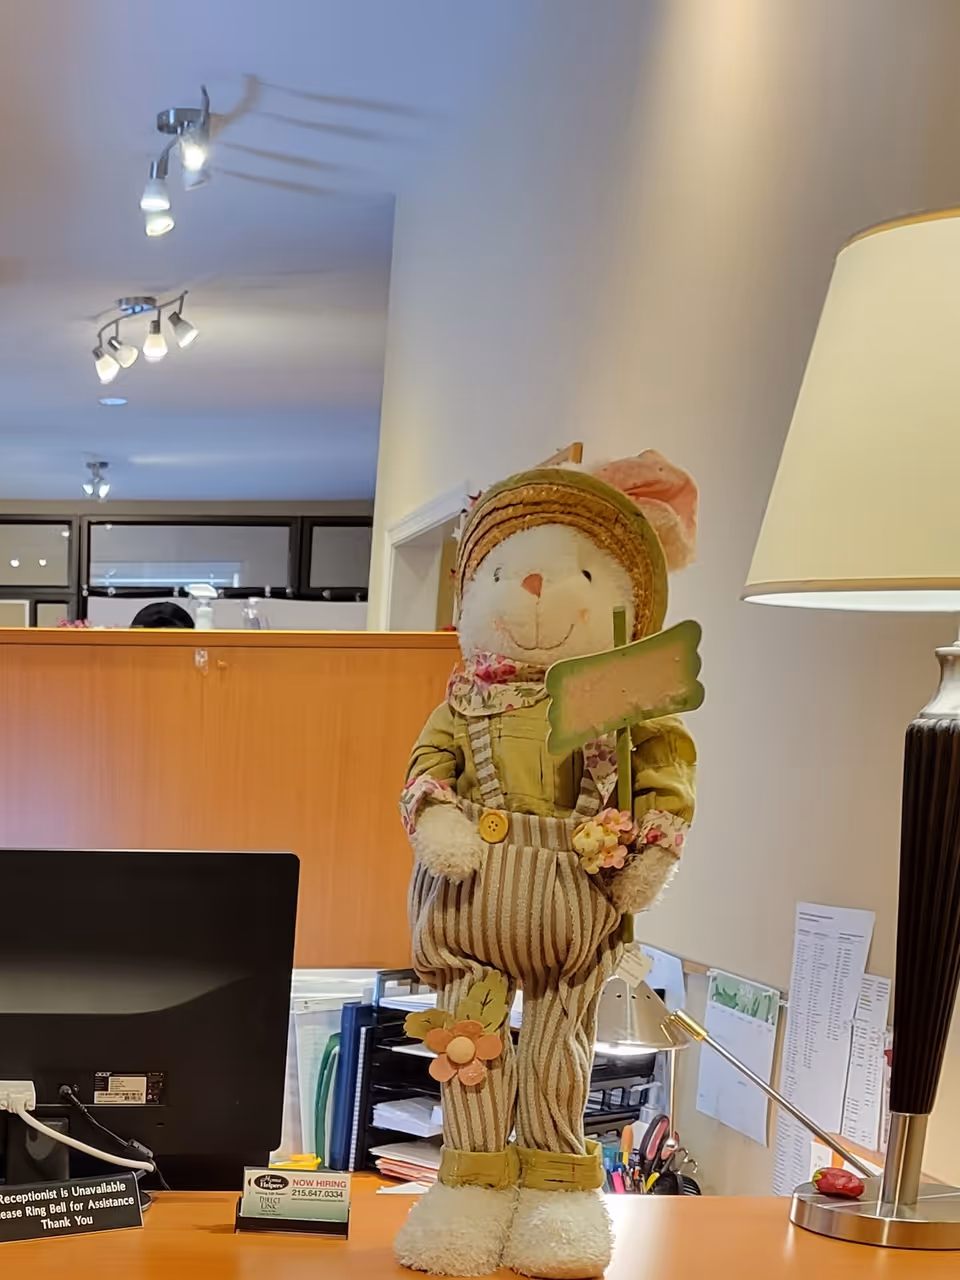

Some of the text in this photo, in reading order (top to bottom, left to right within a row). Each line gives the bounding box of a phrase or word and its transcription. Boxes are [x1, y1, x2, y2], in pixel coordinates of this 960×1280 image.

[60, 1187, 68, 1198] is
[71, 1181, 126, 1197] Unavailable
[292, 1179, 346, 1188] NOW HIRING
[291, 1189, 343, 1198] 215.647.0334
[26, 1206, 46, 1217] Ring
[50, 1202, 66, 1214] Bell
[69, 1201, 84, 1211] for
[88, 1196, 134, 1210] Assistance
[41, 1215, 93, 1230] Thank You
